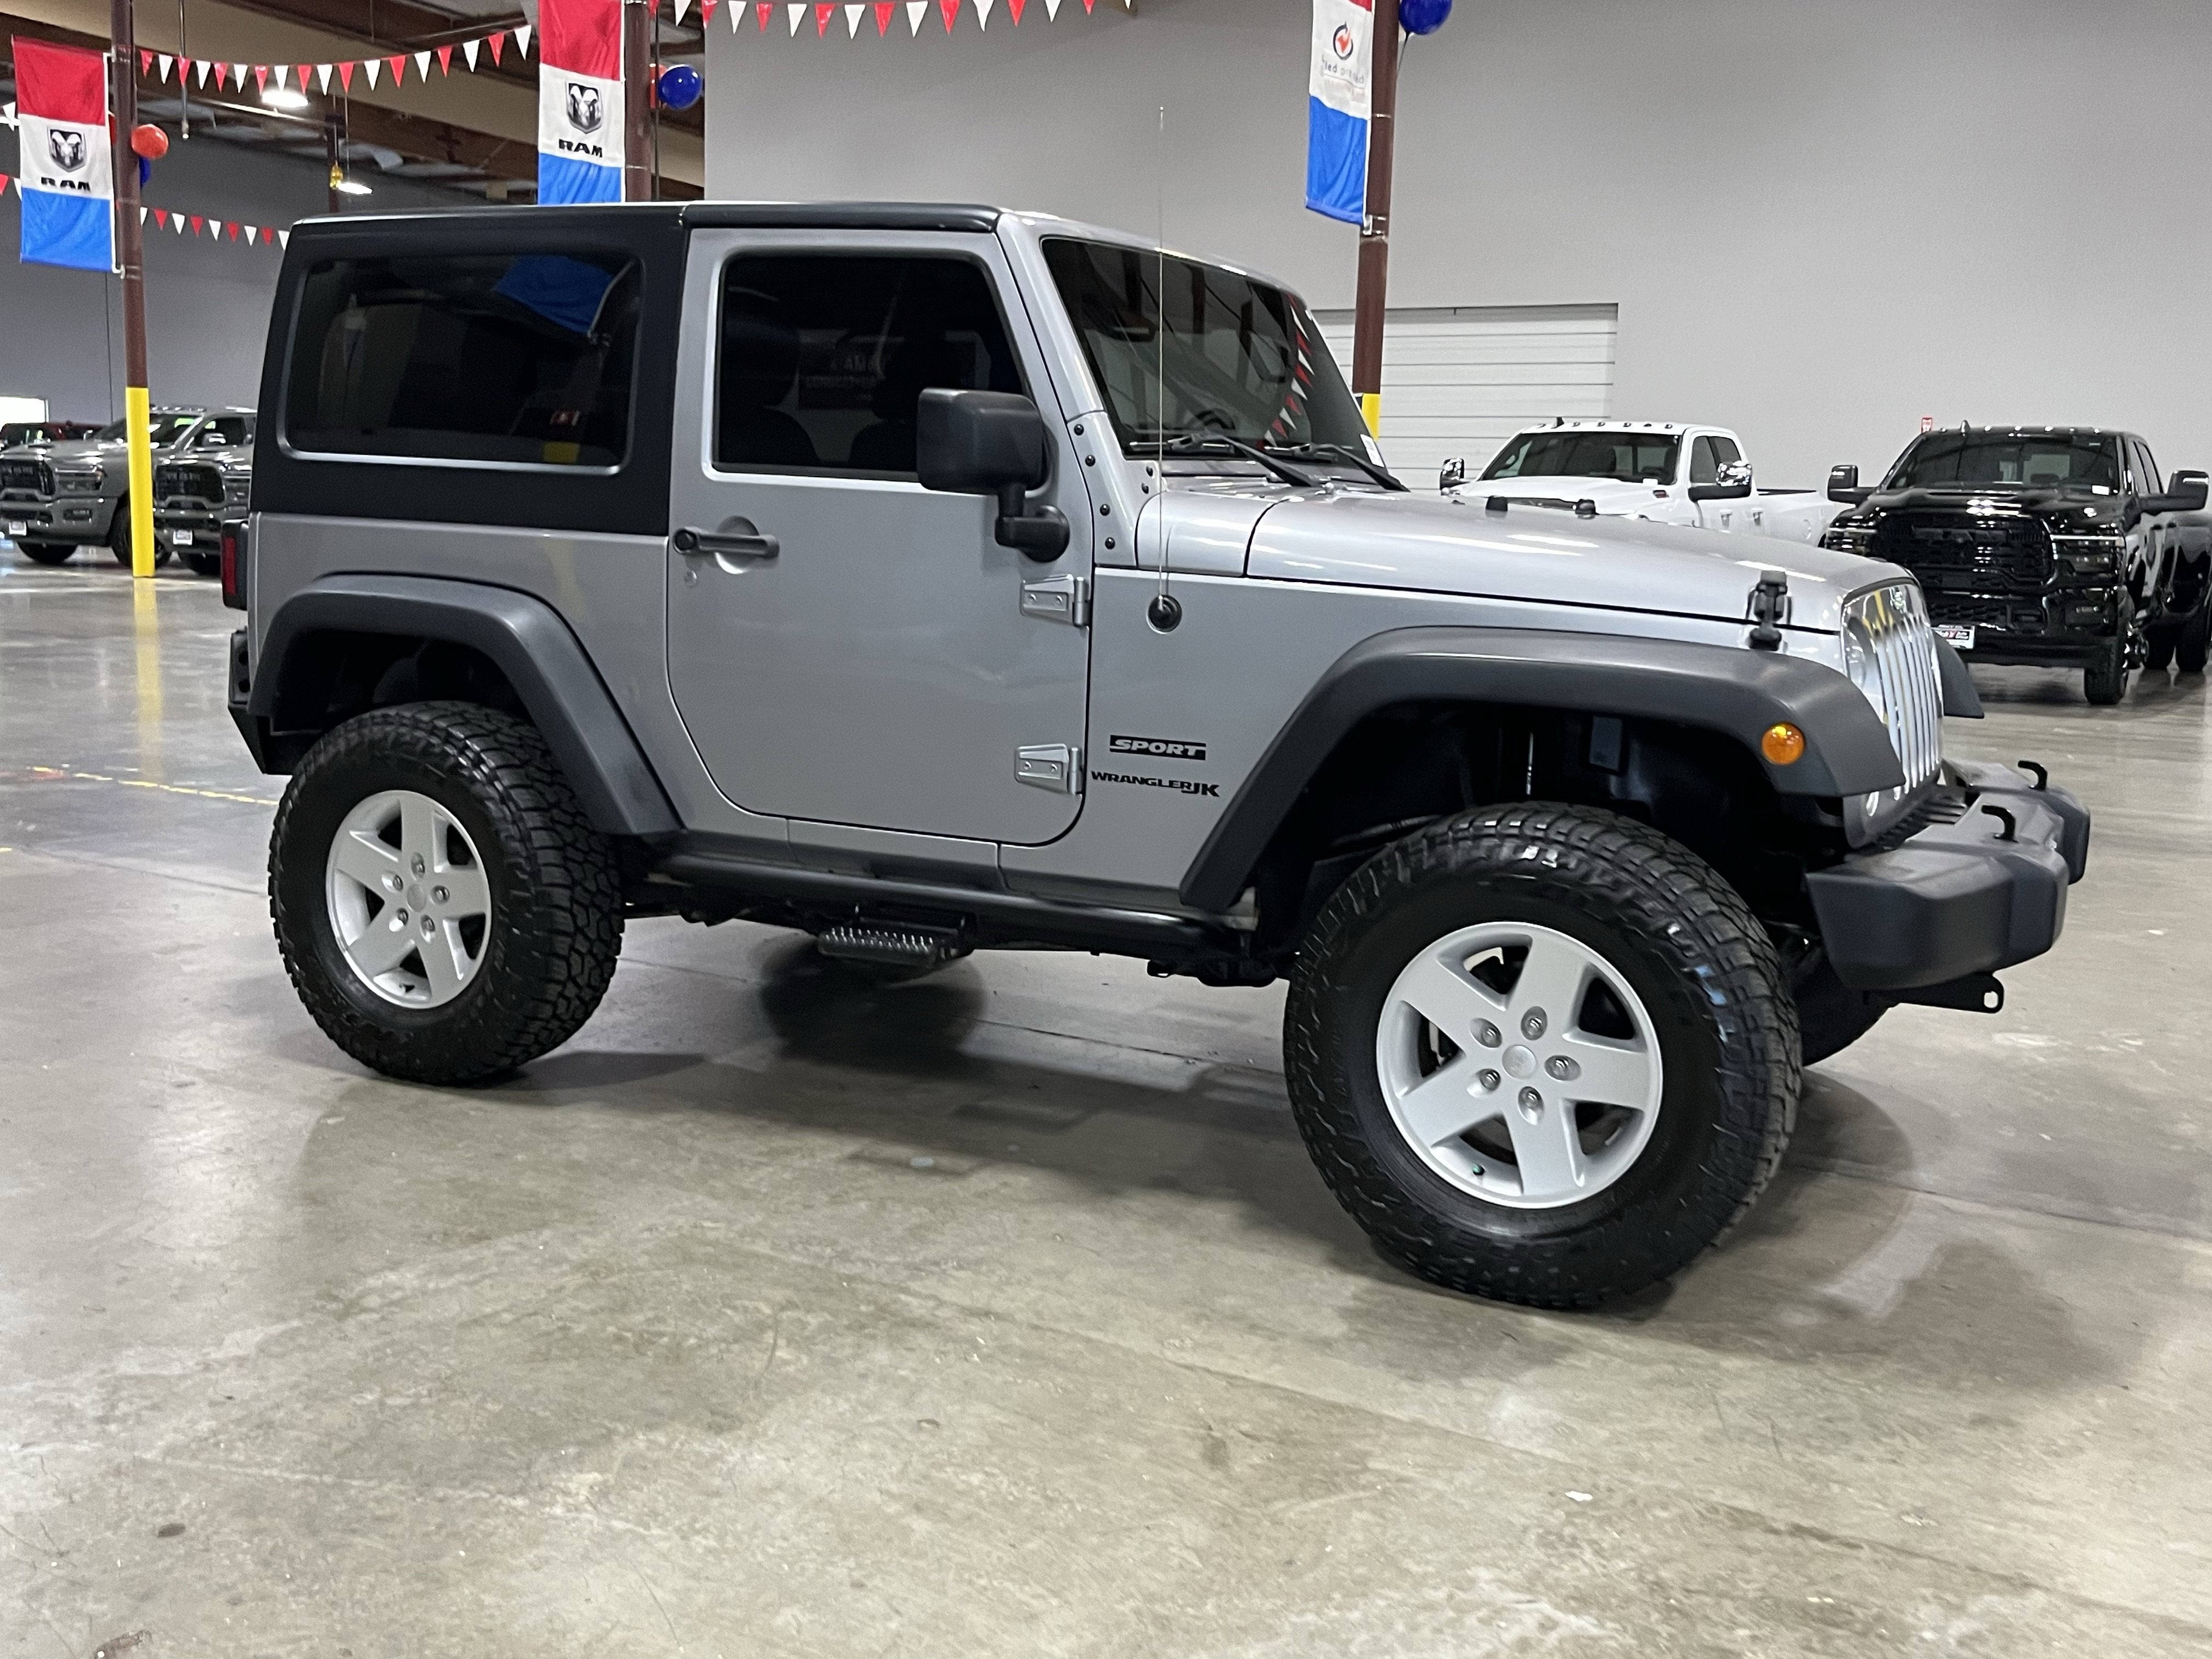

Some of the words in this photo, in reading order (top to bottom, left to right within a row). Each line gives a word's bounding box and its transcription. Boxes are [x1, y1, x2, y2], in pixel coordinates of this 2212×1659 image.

[558, 139, 603, 157] RAM
[41, 177, 91, 193] RAM
[1114, 738, 1201, 758] SPORT
